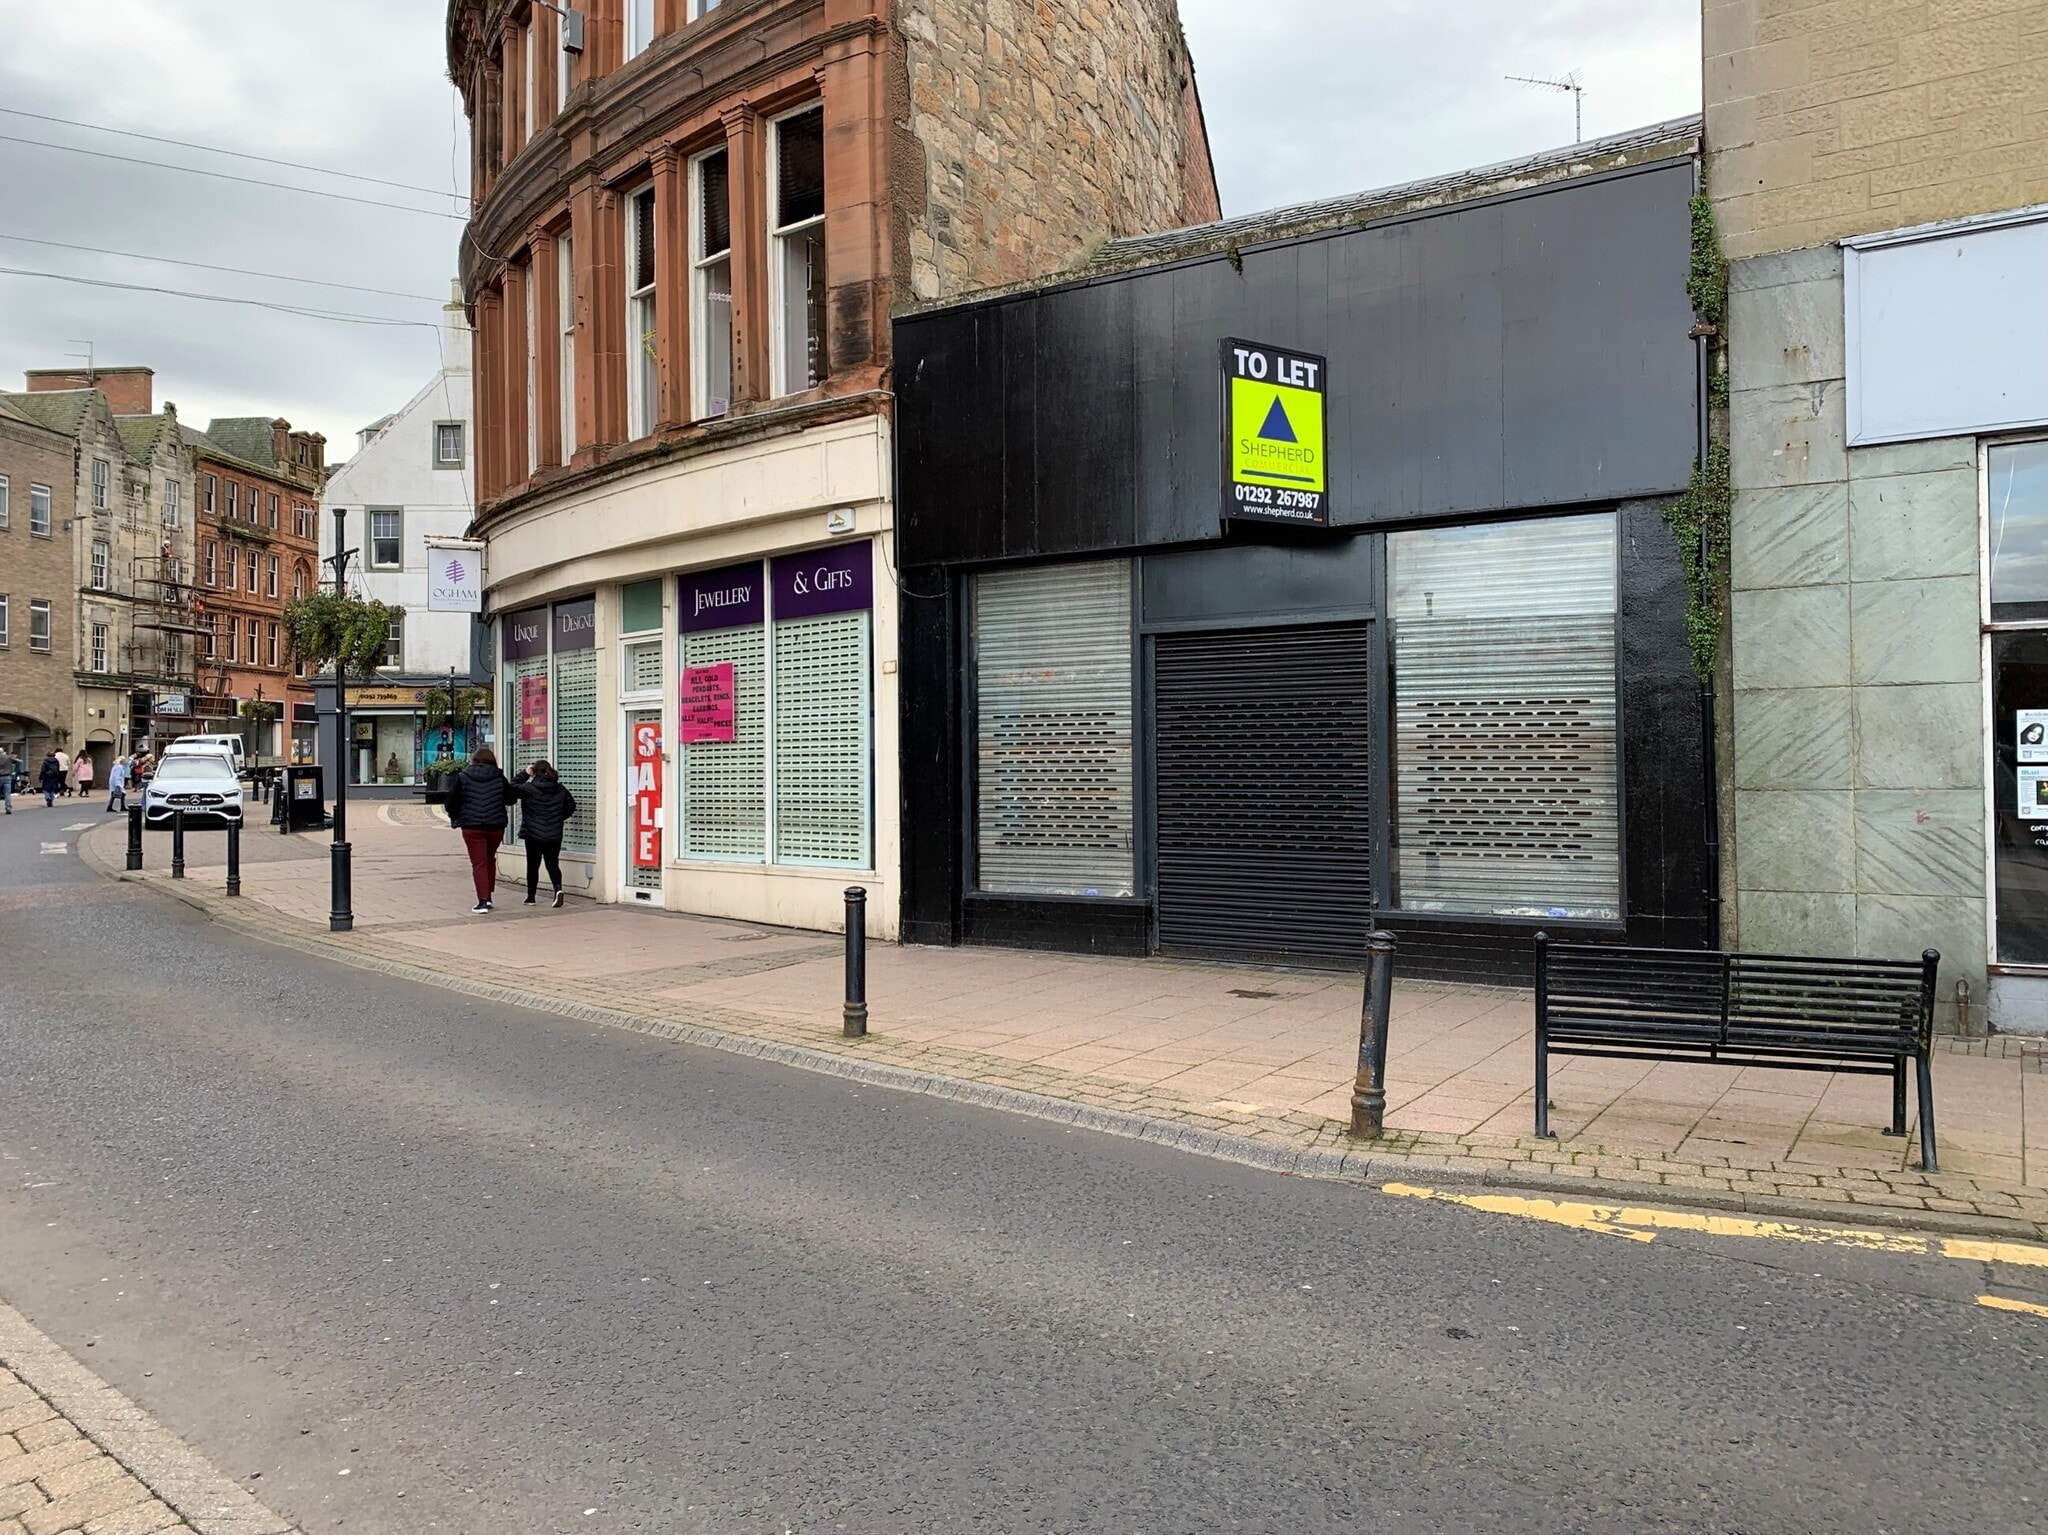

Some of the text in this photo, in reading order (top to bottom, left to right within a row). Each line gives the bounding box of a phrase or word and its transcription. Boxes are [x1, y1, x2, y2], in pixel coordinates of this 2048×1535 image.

[1234, 348, 1318, 389] TO LET
[1240, 438, 1315, 464] SHEPHERD
[1245, 458, 1312, 475] COMMERCIAL
[1235, 484, 1320, 509] 01292 267987
[1243, 504, 1314, 520] www.shepherd.co.uk
[433, 588, 477, 599] OGHAM
[793, 571, 810, 594] &
[638, 727, 657, 861] SALE
